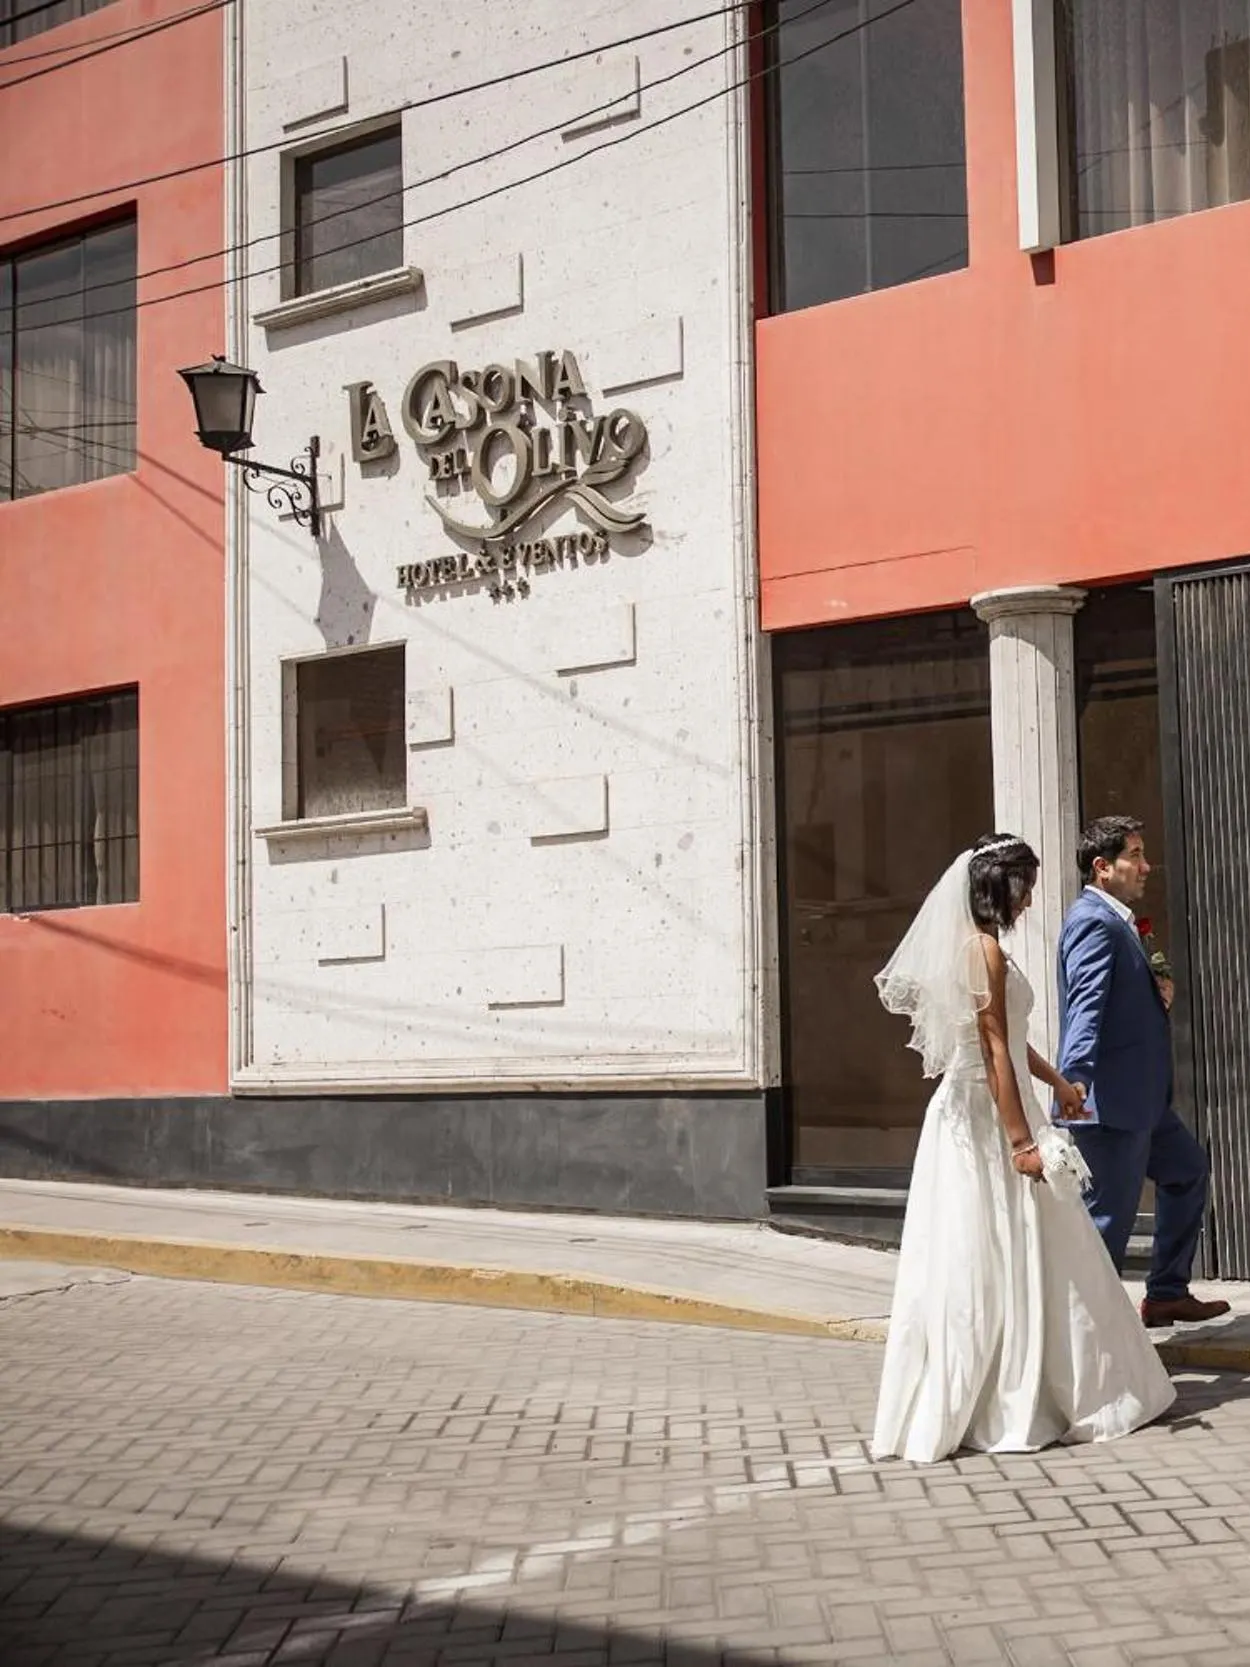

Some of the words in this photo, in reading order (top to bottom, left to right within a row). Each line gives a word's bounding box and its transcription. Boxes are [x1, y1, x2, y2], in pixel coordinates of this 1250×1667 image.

[343, 380, 396, 462] LA
[402, 349, 592, 444] CASONA
[430, 448, 474, 481] DEL
[471, 407, 649, 507] OLIVO
[397, 552, 475, 589] HOTEL
[474, 547, 500, 575] &
[500, 531, 610, 568] EVENTOS
